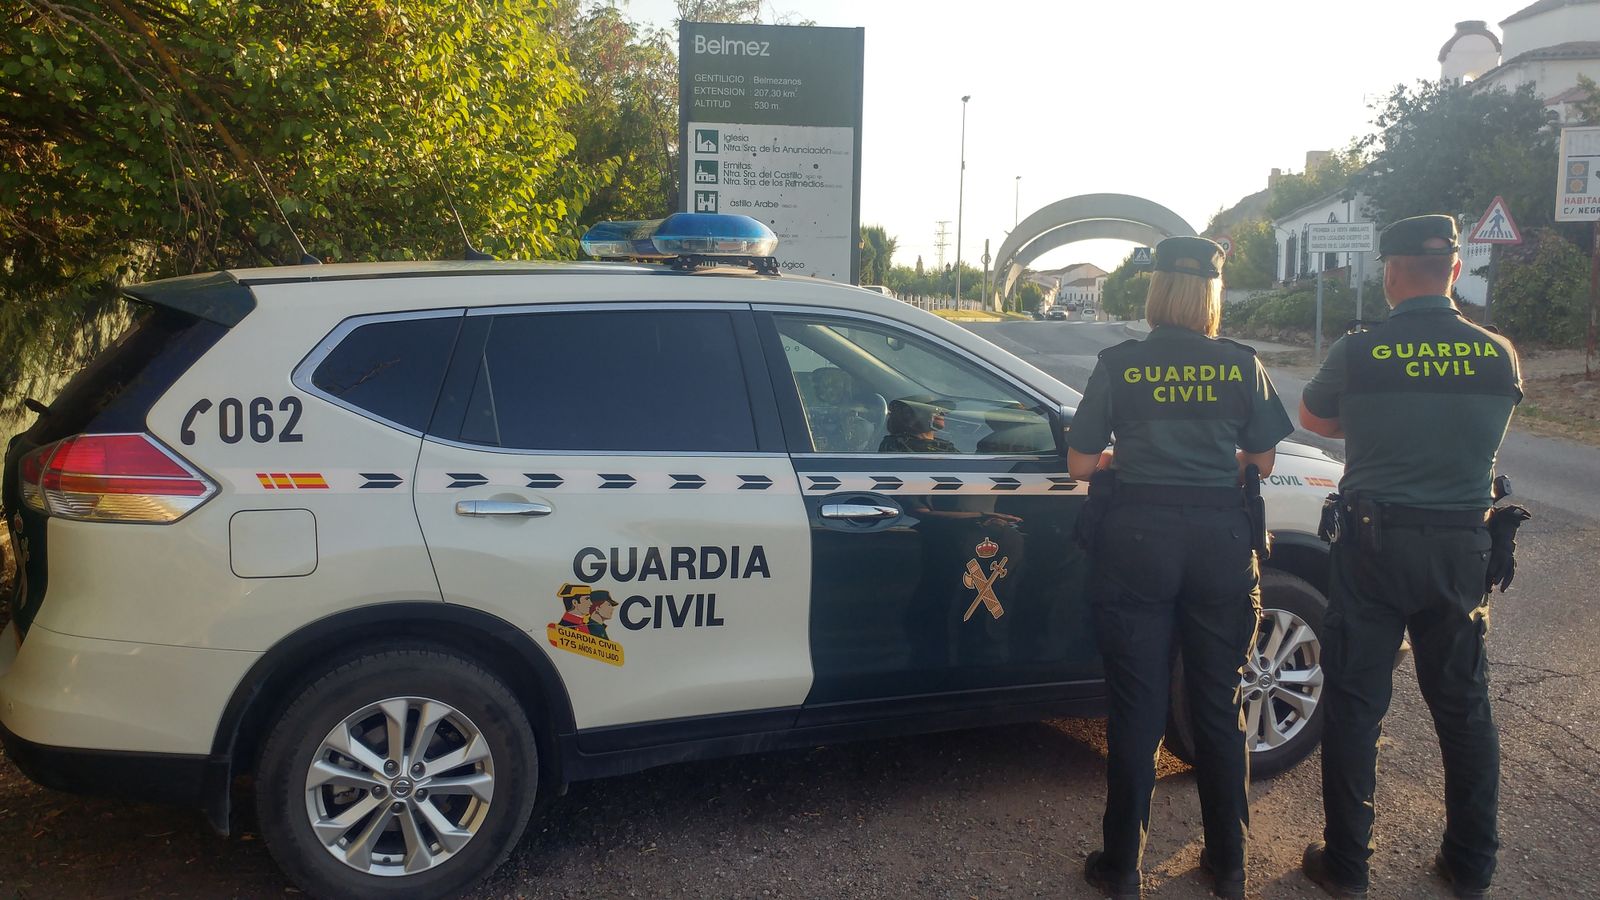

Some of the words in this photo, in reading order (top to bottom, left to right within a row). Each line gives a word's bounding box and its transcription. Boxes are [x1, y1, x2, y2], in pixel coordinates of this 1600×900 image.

[694, 34, 770, 57] Belmez
[694, 74, 745, 84] GENTILICIO
[753, 75, 802, 86] Belmezanos
[694, 87, 745, 96] EXTENSION
[694, 99, 731, 108] ALTITUD
[754, 101, 770, 110] 530
[723, 134, 749, 143] Iglesia
[760, 145, 771, 153] de
[772, 145, 781, 153] la
[759, 170, 772, 179] del
[773, 171, 803, 179] Castillo
[759, 178, 770, 187] de
[772, 178, 783, 187] los
[754, 199, 779, 208] Arabe
[1564, 196, 1600, 205] HABITA
[1371, 341, 1500, 360] GUARDIA
[1123, 364, 1243, 383] GUARDIA
[1405, 360, 1476, 377] CIVIL
[1153, 385, 1218, 403] CIVIL
[218, 395, 304, 444] 062
[1269, 474, 1303, 486] CIVIL
[572, 545, 771, 583] GUARDIA
[619, 593, 725, 631] CIVIL
[558, 627, 597, 645] GUARDIA
[598, 640, 620, 652] CIVIL
[559, 637, 577, 649] 175
[598, 650, 605, 658] TU
[605, 651, 620, 662] LADO
